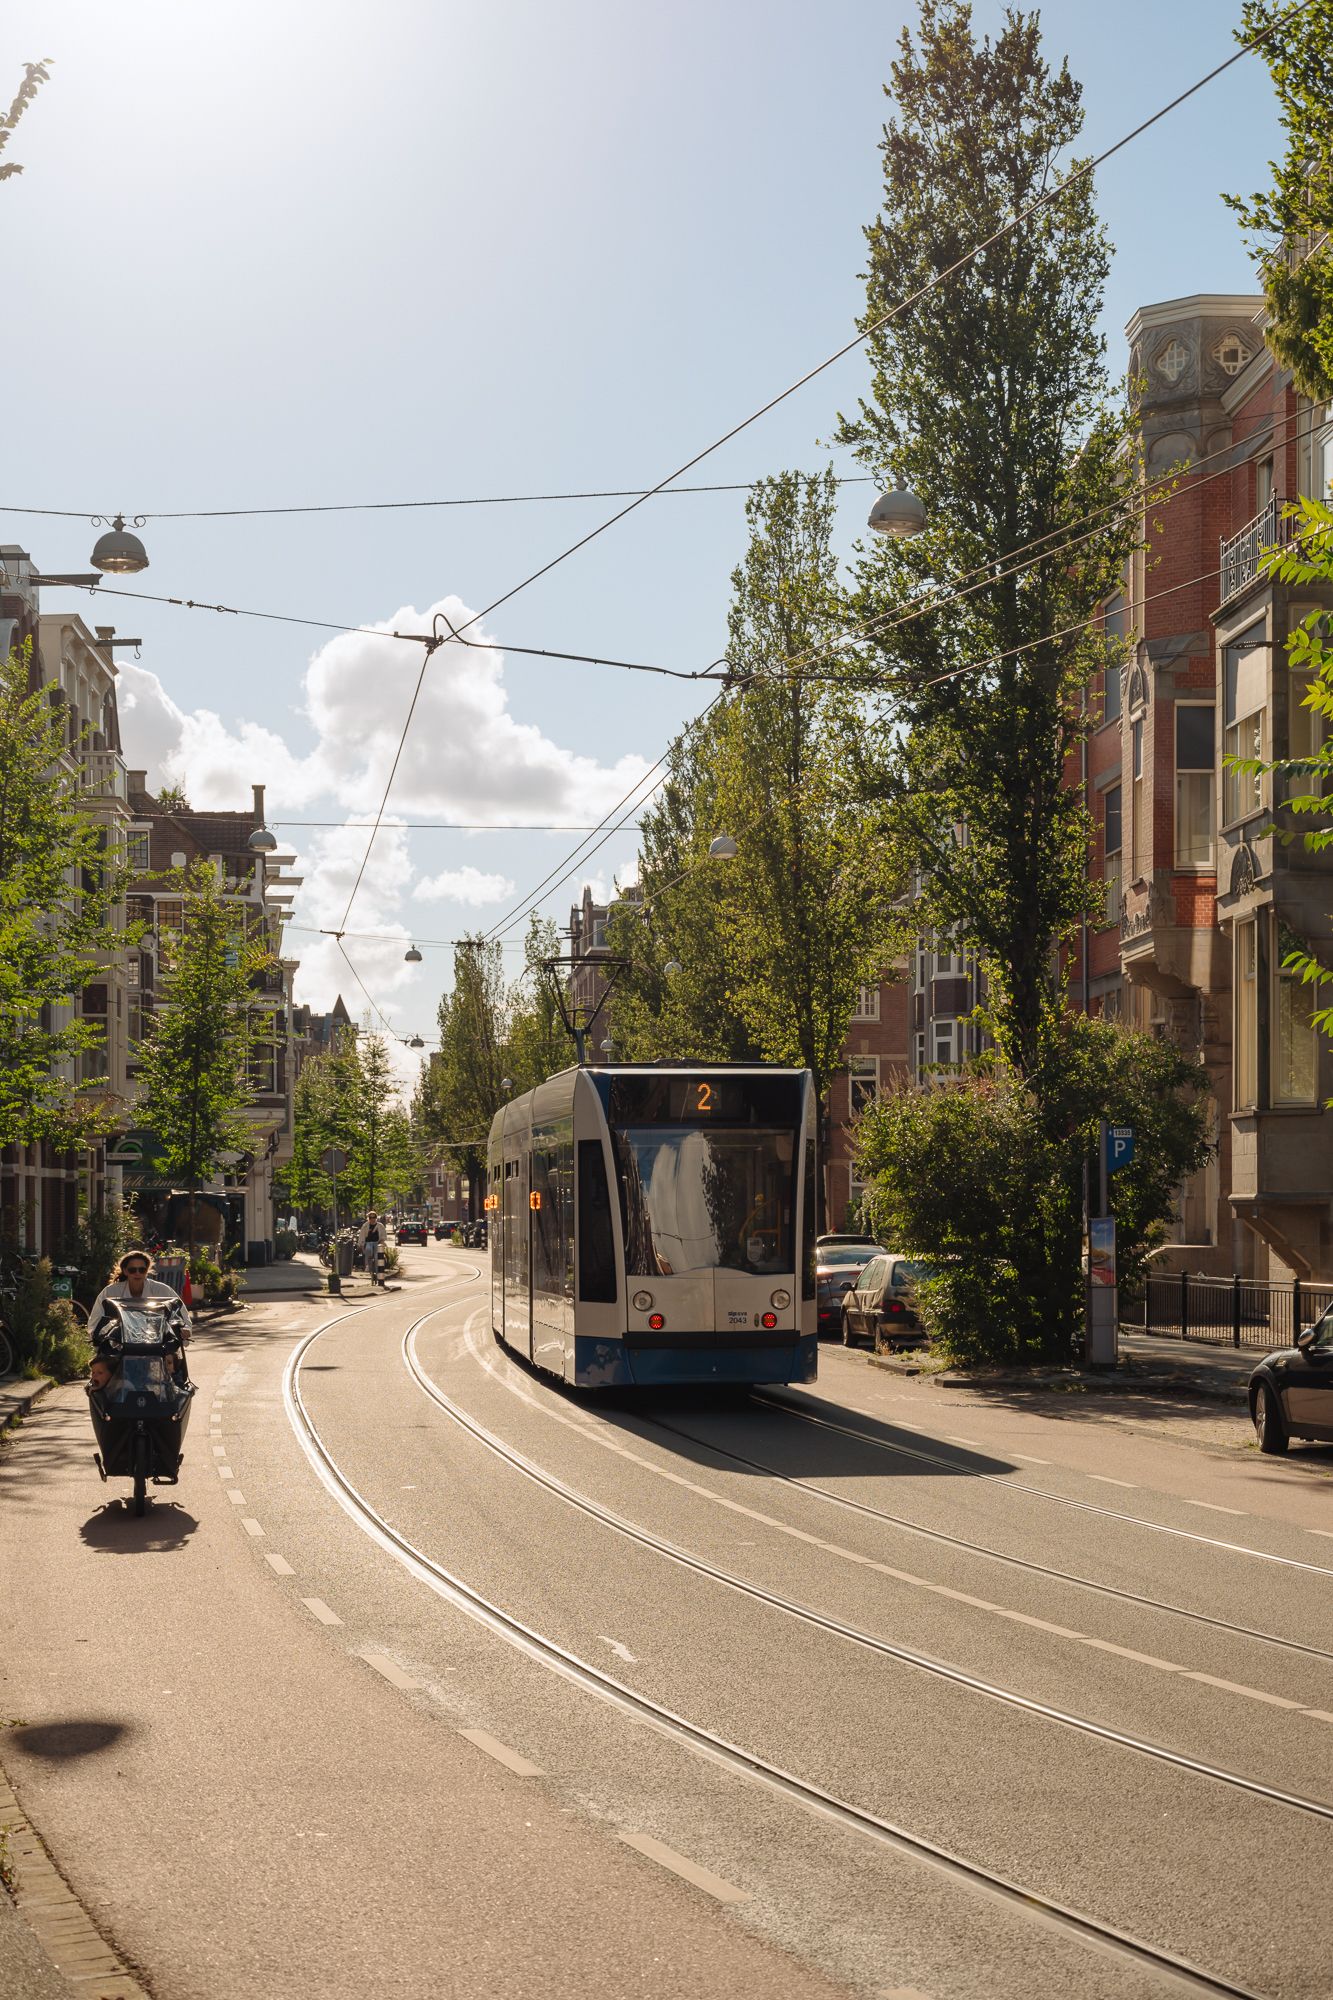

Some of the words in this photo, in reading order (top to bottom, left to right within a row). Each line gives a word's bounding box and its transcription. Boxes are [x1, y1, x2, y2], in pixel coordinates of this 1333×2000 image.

[697, 1083, 711, 1110] 2
[1114, 1140, 1126, 1158] P
[728, 1316, 747, 1324] 2043
